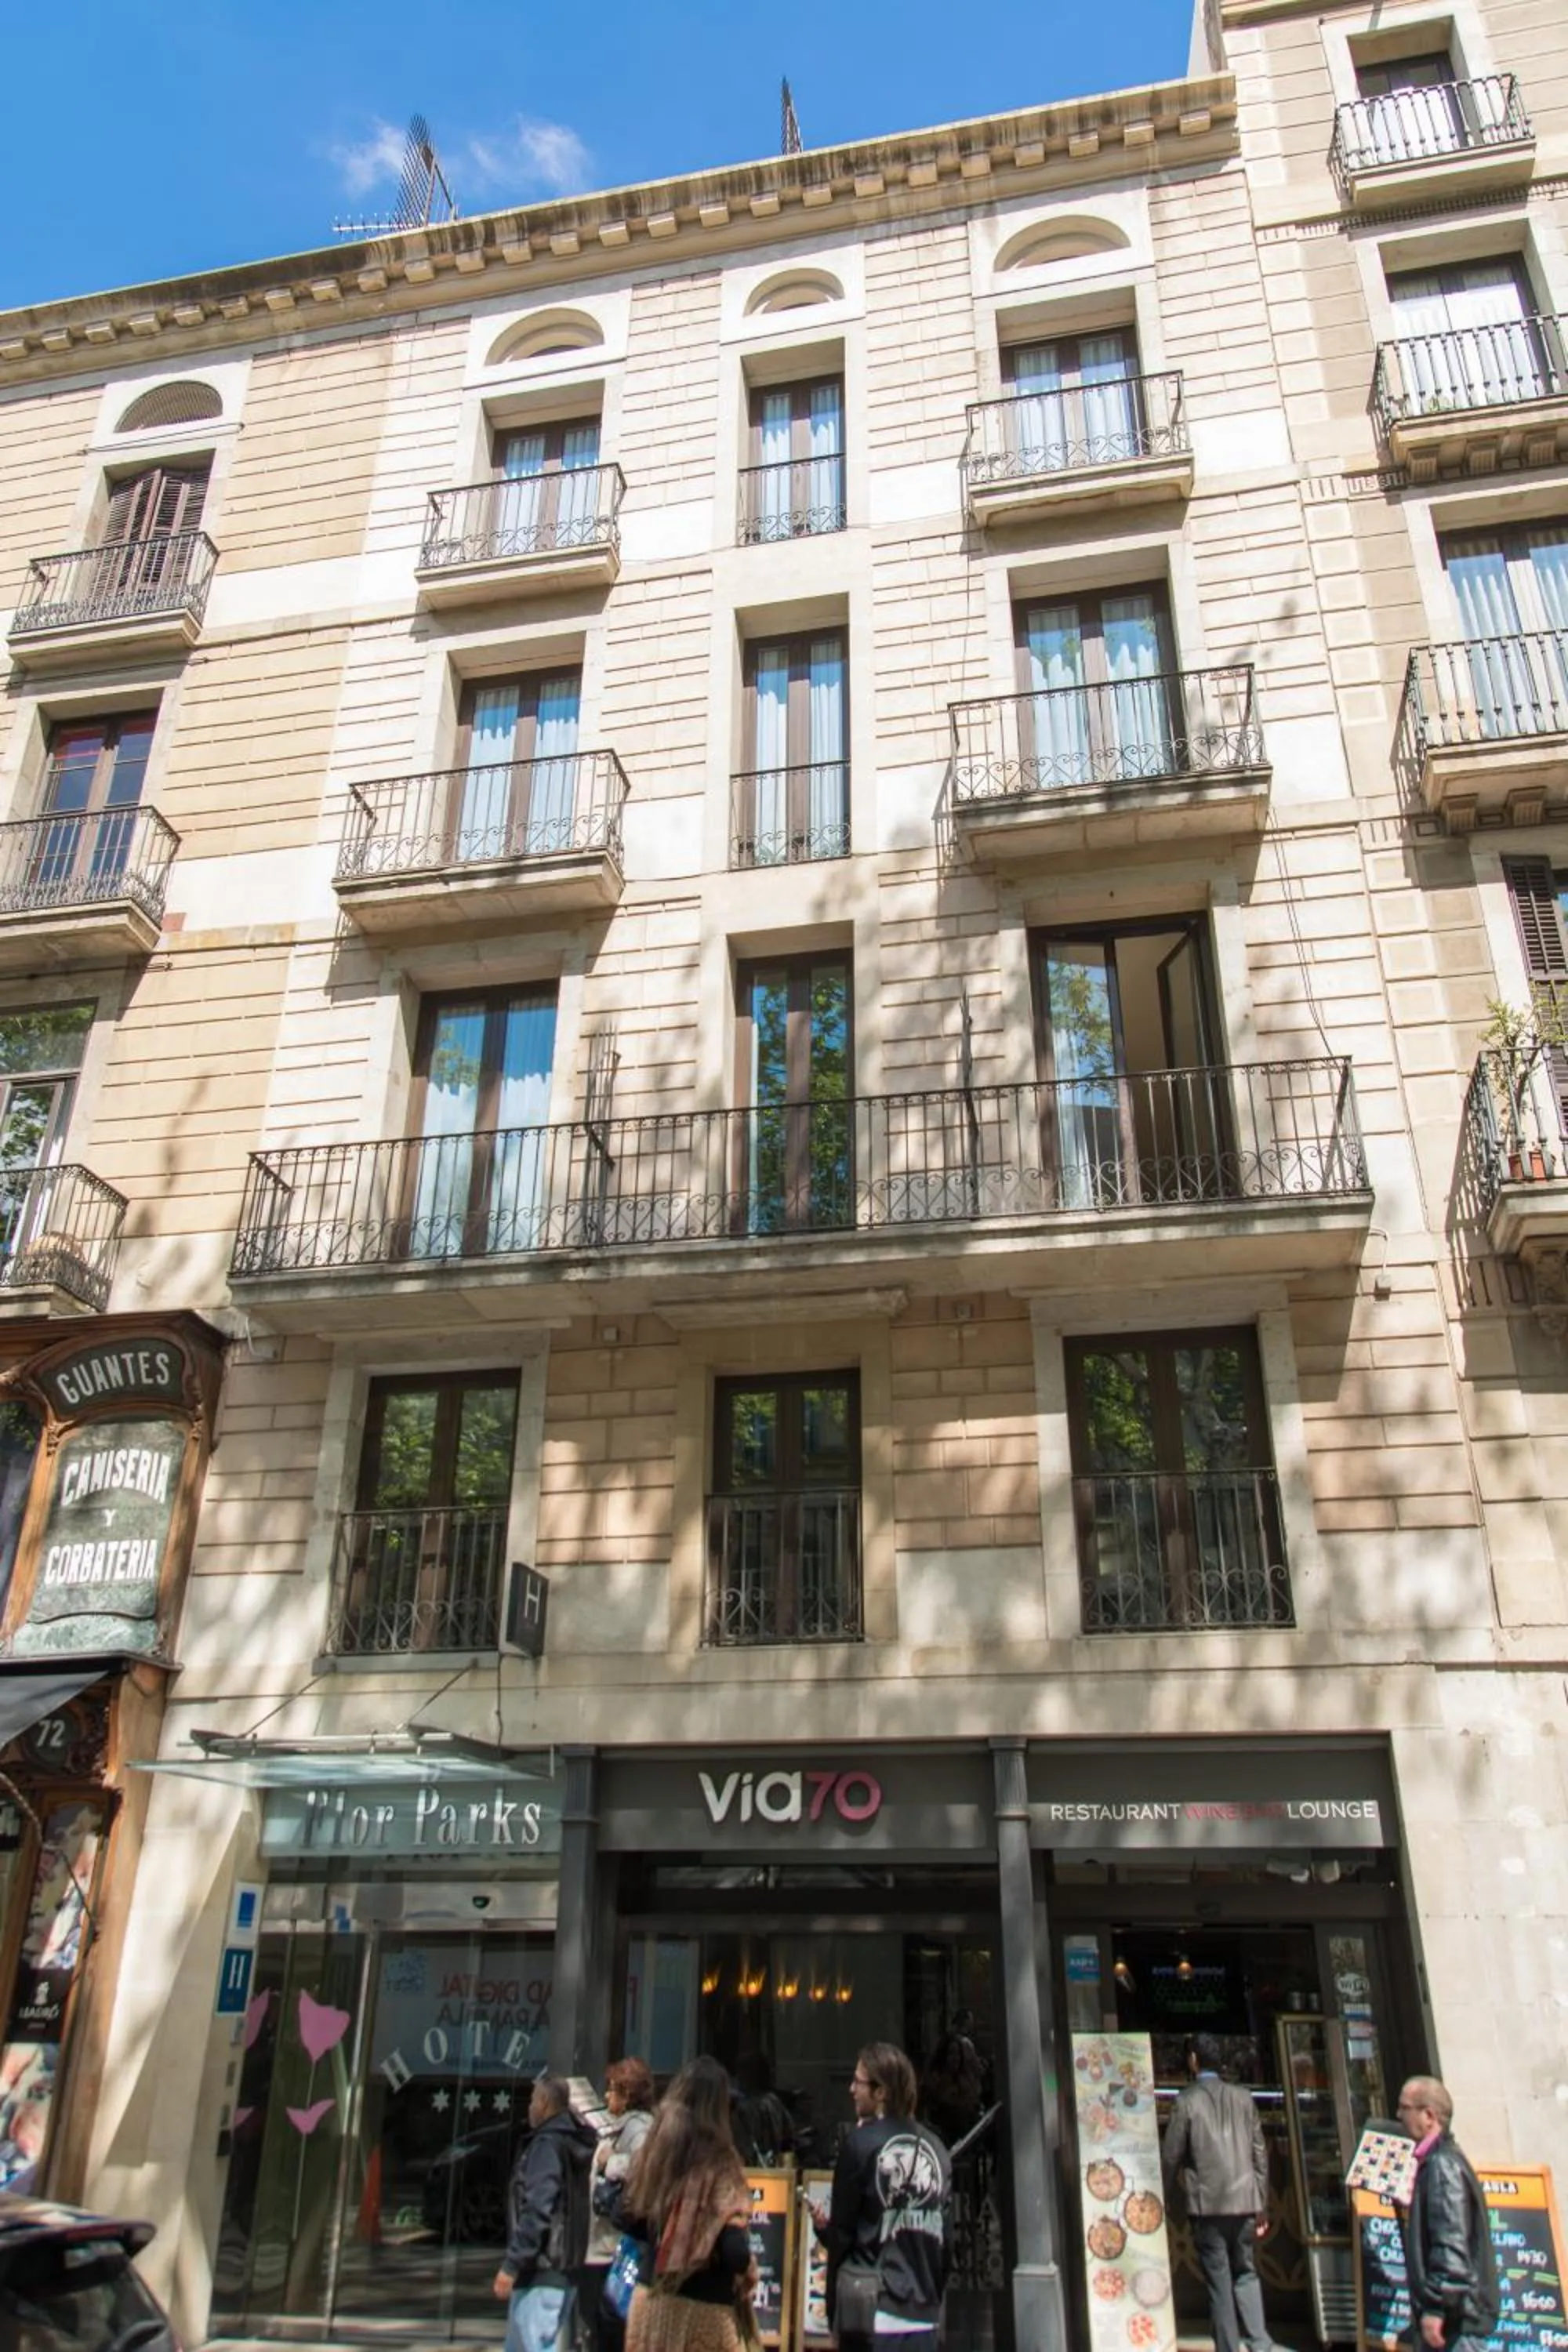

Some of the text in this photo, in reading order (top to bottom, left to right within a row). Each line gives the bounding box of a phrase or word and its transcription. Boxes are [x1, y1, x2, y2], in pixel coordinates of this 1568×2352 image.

[56, 1351, 170, 1405] GUANTES
[60, 1446, 171, 1507] CAMISERIA
[102, 1509, 117, 1528] Y
[44, 1538, 158, 1587] CORBATERIA
[524, 1573, 541, 1624] H
[35, 1719, 65, 1748] 72
[413, 1786, 541, 1845] Parks
[1051, 1803, 1180, 1821] RESTAURANT
[1287, 1800, 1376, 1820] LOUNGE
